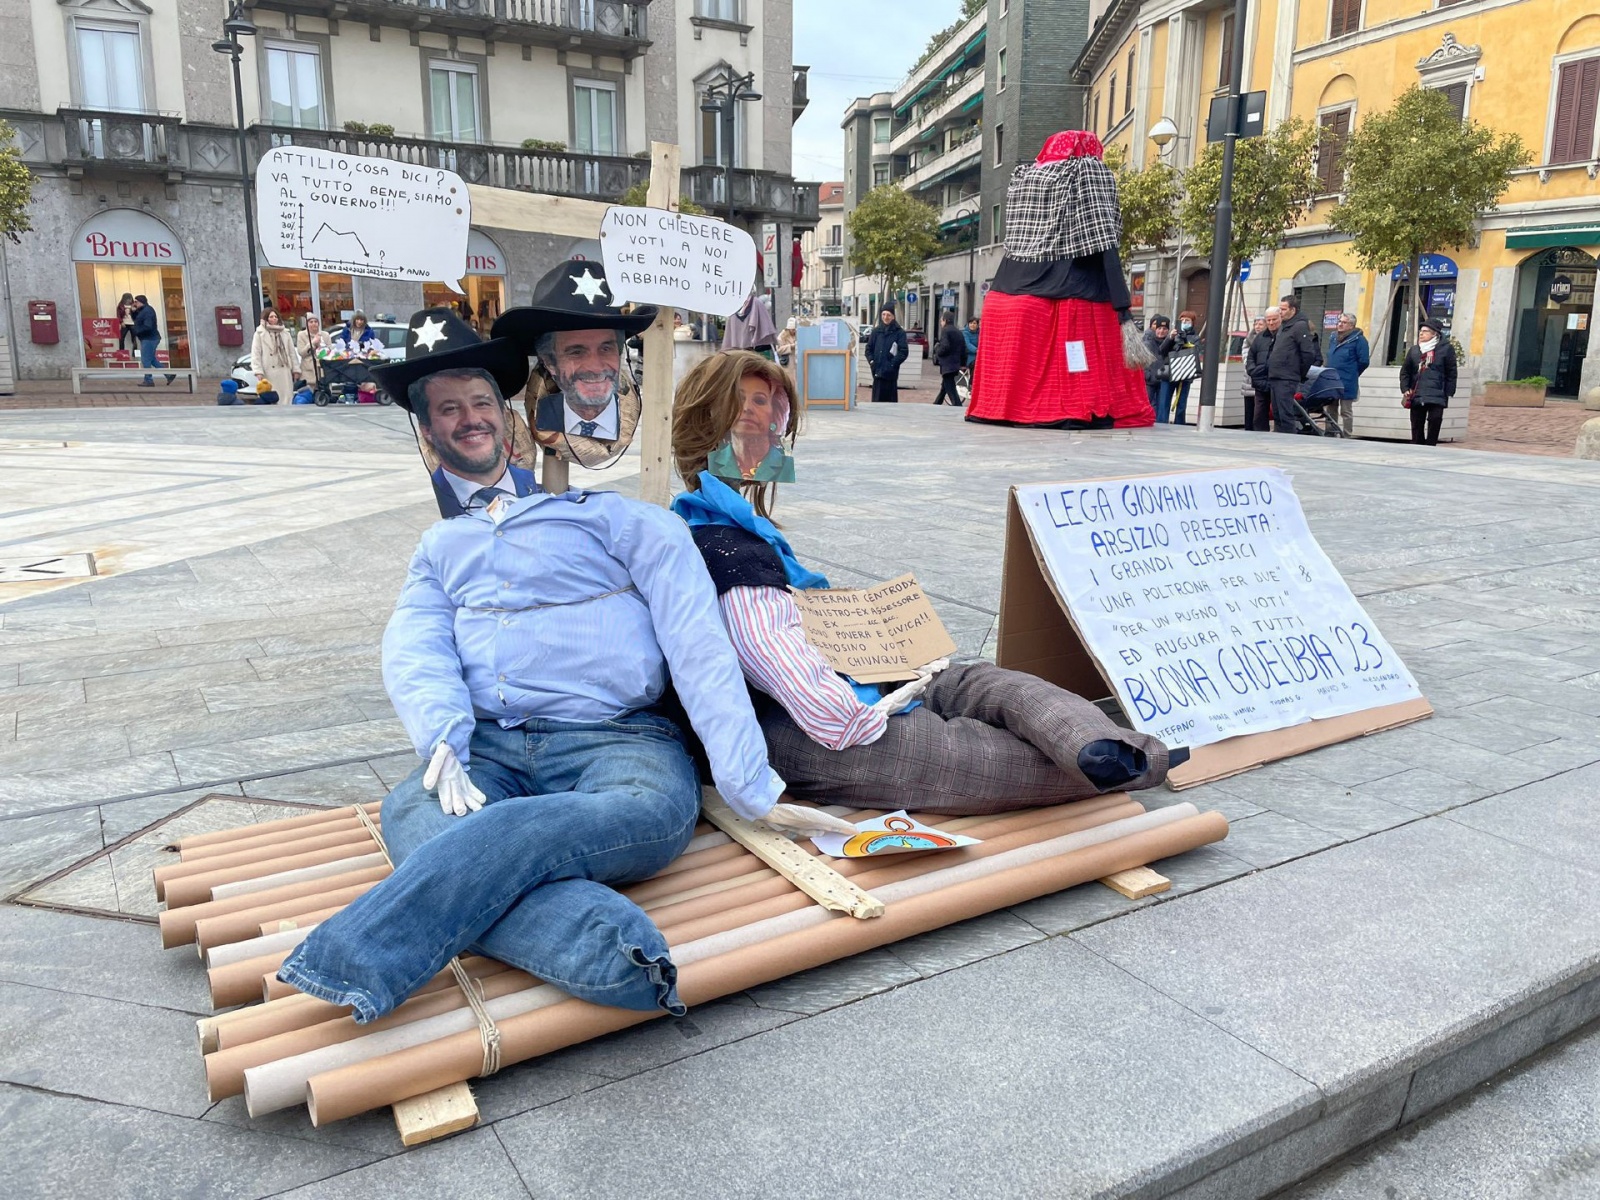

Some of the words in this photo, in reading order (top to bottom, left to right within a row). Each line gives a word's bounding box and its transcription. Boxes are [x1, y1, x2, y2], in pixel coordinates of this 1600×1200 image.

[355, 162, 389, 176] COSA
[402, 169, 429, 184] DICI
[271, 173, 289, 184] VA
[301, 175, 353, 193] TUTTO
[414, 192, 453, 206] SIAMO
[280, 187, 297, 199] AL
[310, 191, 396, 212] GOVERNO!!!
[613, 212, 647, 227] NON
[658, 216, 734, 243] CHIEDERE
[85, 231, 172, 258] Brums
[629, 235, 664, 248] VOTI
[681, 241, 690, 252] A
[704, 245, 728, 260] NOI
[406, 268, 430, 277] ANNO
[618, 252, 645, 264] CHE
[660, 255, 687, 269] NON
[702, 262, 723, 278] NE
[620, 271, 690, 291] ABBIAMO
[1043, 486, 1115, 528] LEGA
[1121, 484, 1199, 517] GIOVANI
[1213, 480, 1272, 508] BUSTO
[1090, 523, 1170, 558] ARSIZIO
[1180, 512, 1280, 543] PRESENTA:
[1089, 567, 1100, 587] I
[1110, 554, 1175, 582] GRANDI
[1186, 542, 1257, 567] CLASSICI
[863, 578, 917, 603] CENTRODX
[1142, 578, 1211, 601] POLTRONA
[1220, 575, 1248, 590] PER
[870, 592, 921, 615] ASSESSORE
[1152, 613, 1170, 629] UN
[1174, 605, 1218, 624] PUGNO
[1228, 600, 1243, 614] DI
[822, 620, 839, 629] EX
[835, 630, 872, 640] POVERA
[876, 630, 884, 638] E
[888, 612, 931, 637] CIVICA!!
[880, 638, 913, 652] VOTI
[1118, 648, 1143, 667] ED
[1154, 630, 1221, 658] AUGURA
[1230, 624, 1243, 638] A
[1251, 614, 1305, 633] TUTTI
[847, 655, 909, 668] CHIUNQUE
[1123, 657, 1222, 722] BUONA
[1270, 695, 1294, 707] THOMAS
[1317, 684, 1340, 696] MAURO
[1155, 719, 1195, 740] STEFANO
